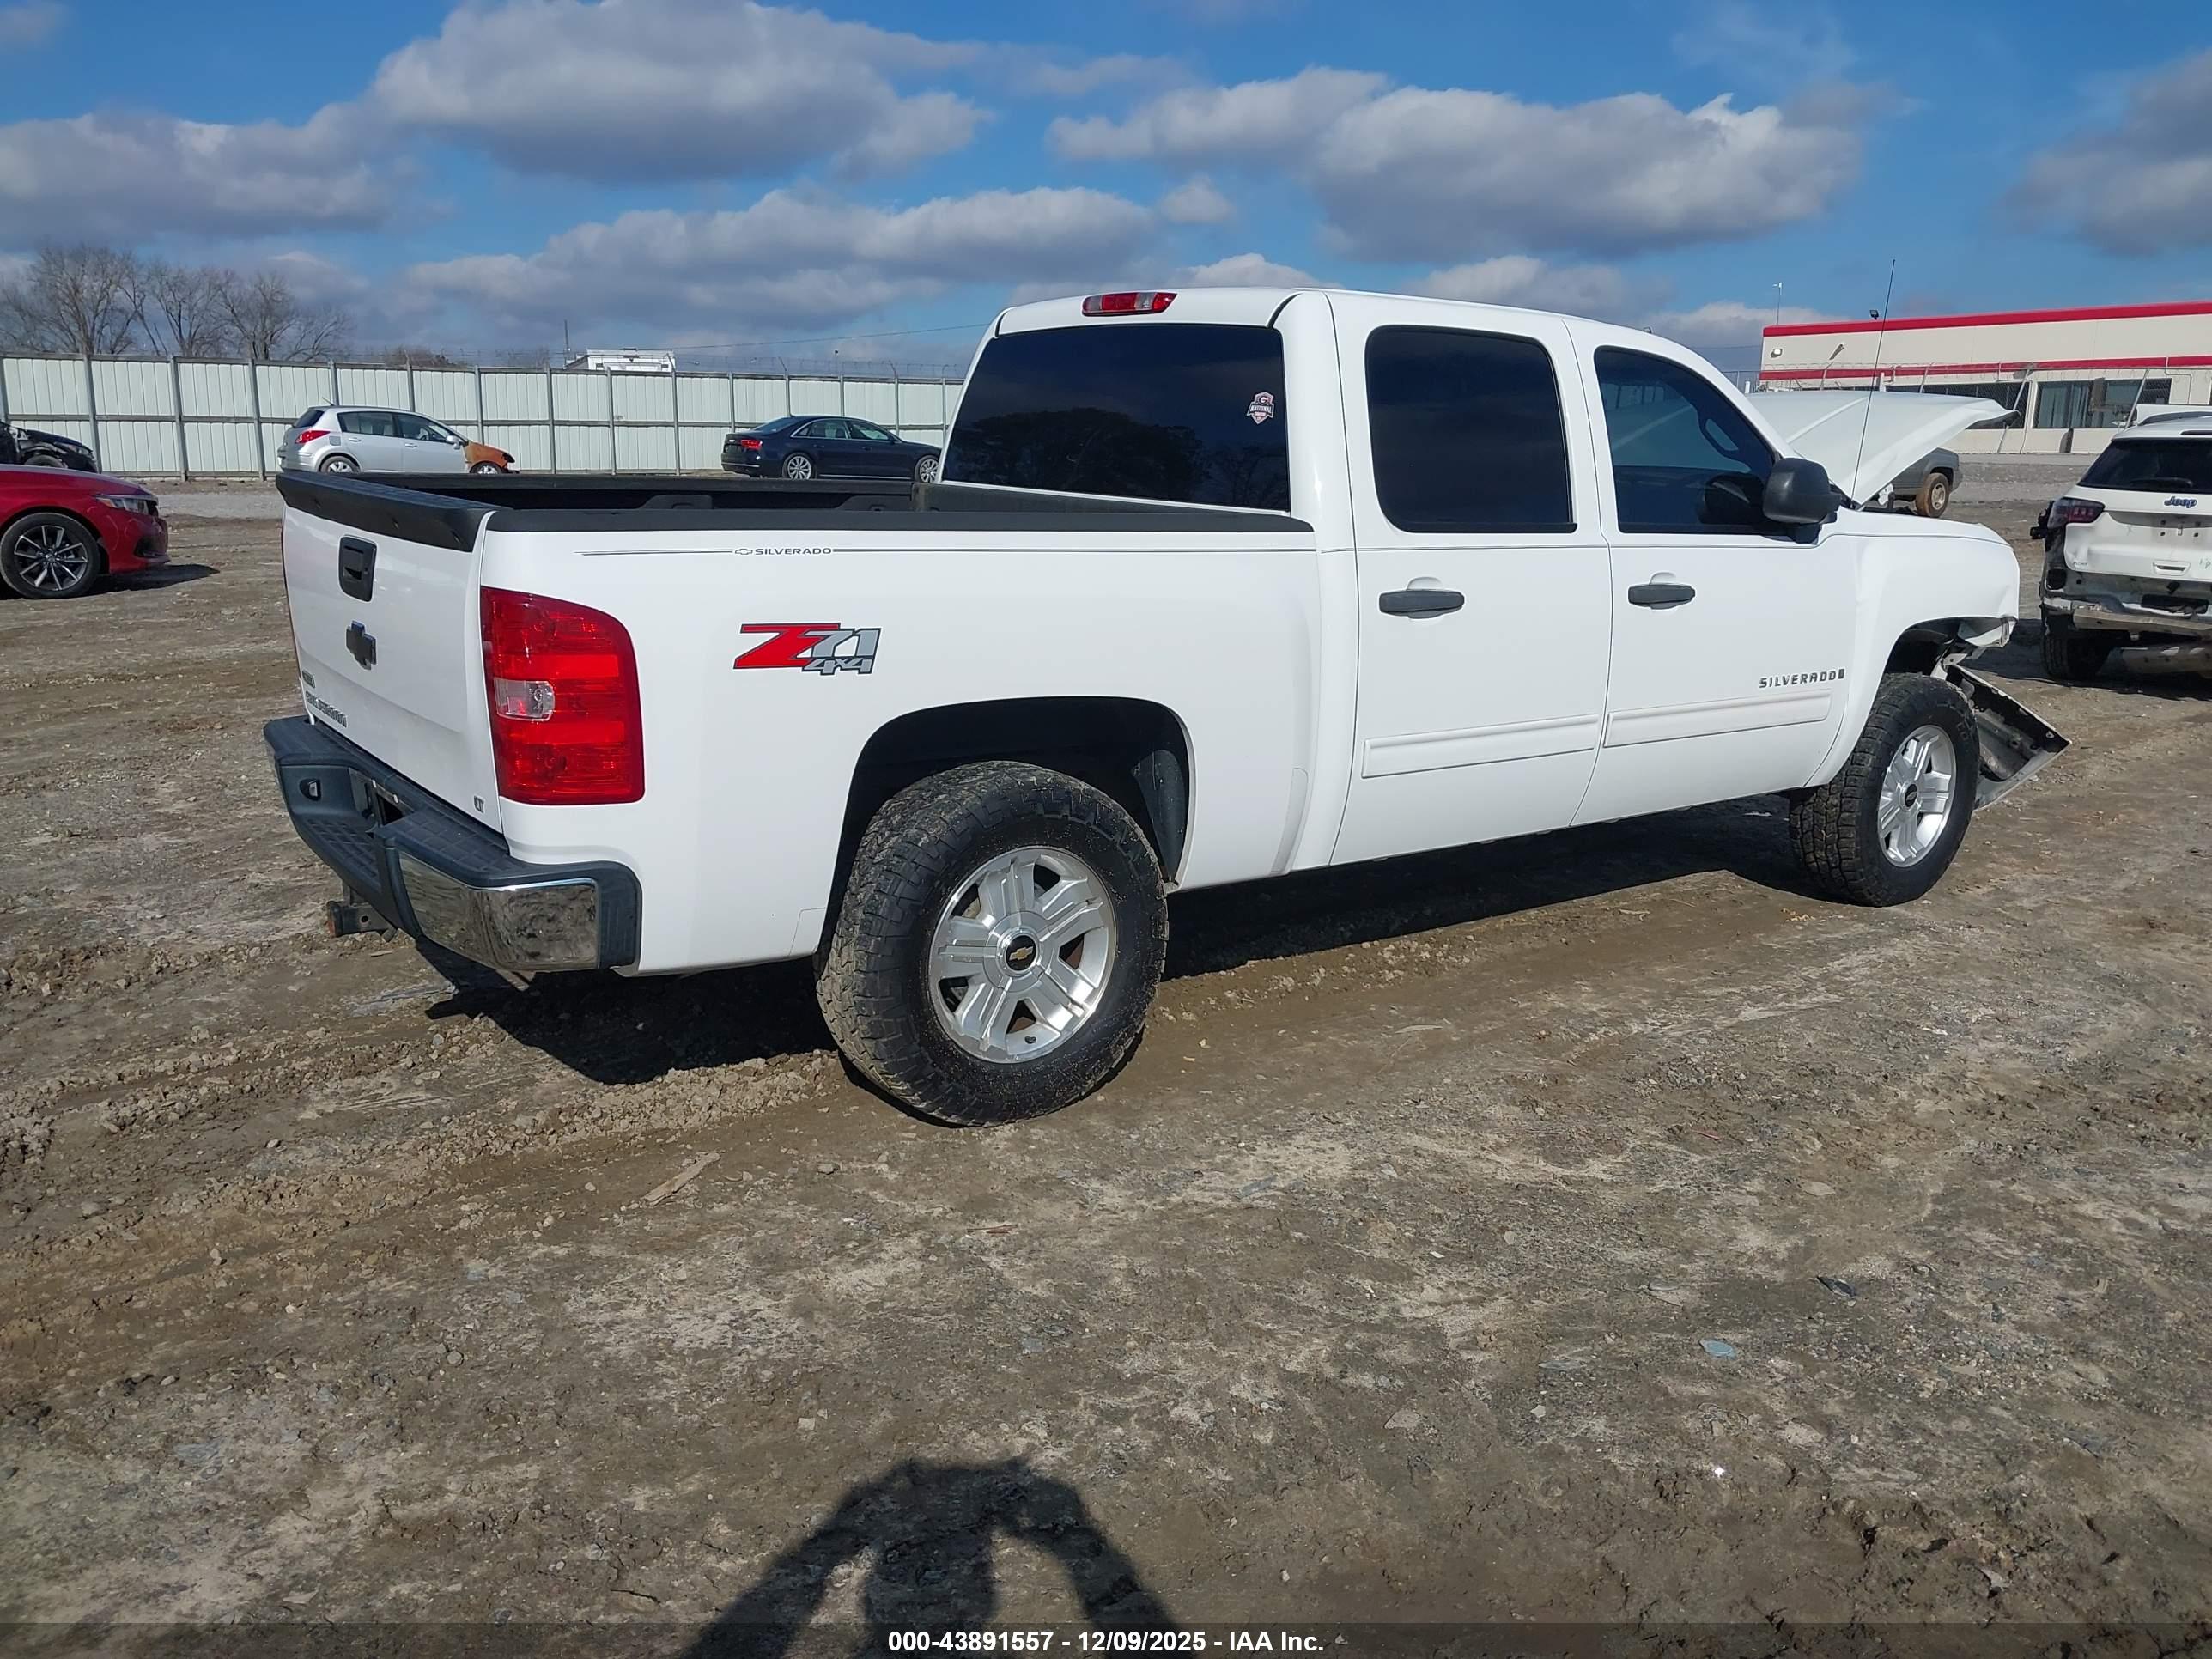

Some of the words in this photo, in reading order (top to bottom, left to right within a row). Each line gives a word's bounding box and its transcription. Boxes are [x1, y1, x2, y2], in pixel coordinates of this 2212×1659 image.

[2164, 495, 2197, 508] Jeep
[755, 547, 832, 556] SILVERADO
[732, 623, 882, 670] Z71
[1759, 670, 1837, 689] SILVERADO
